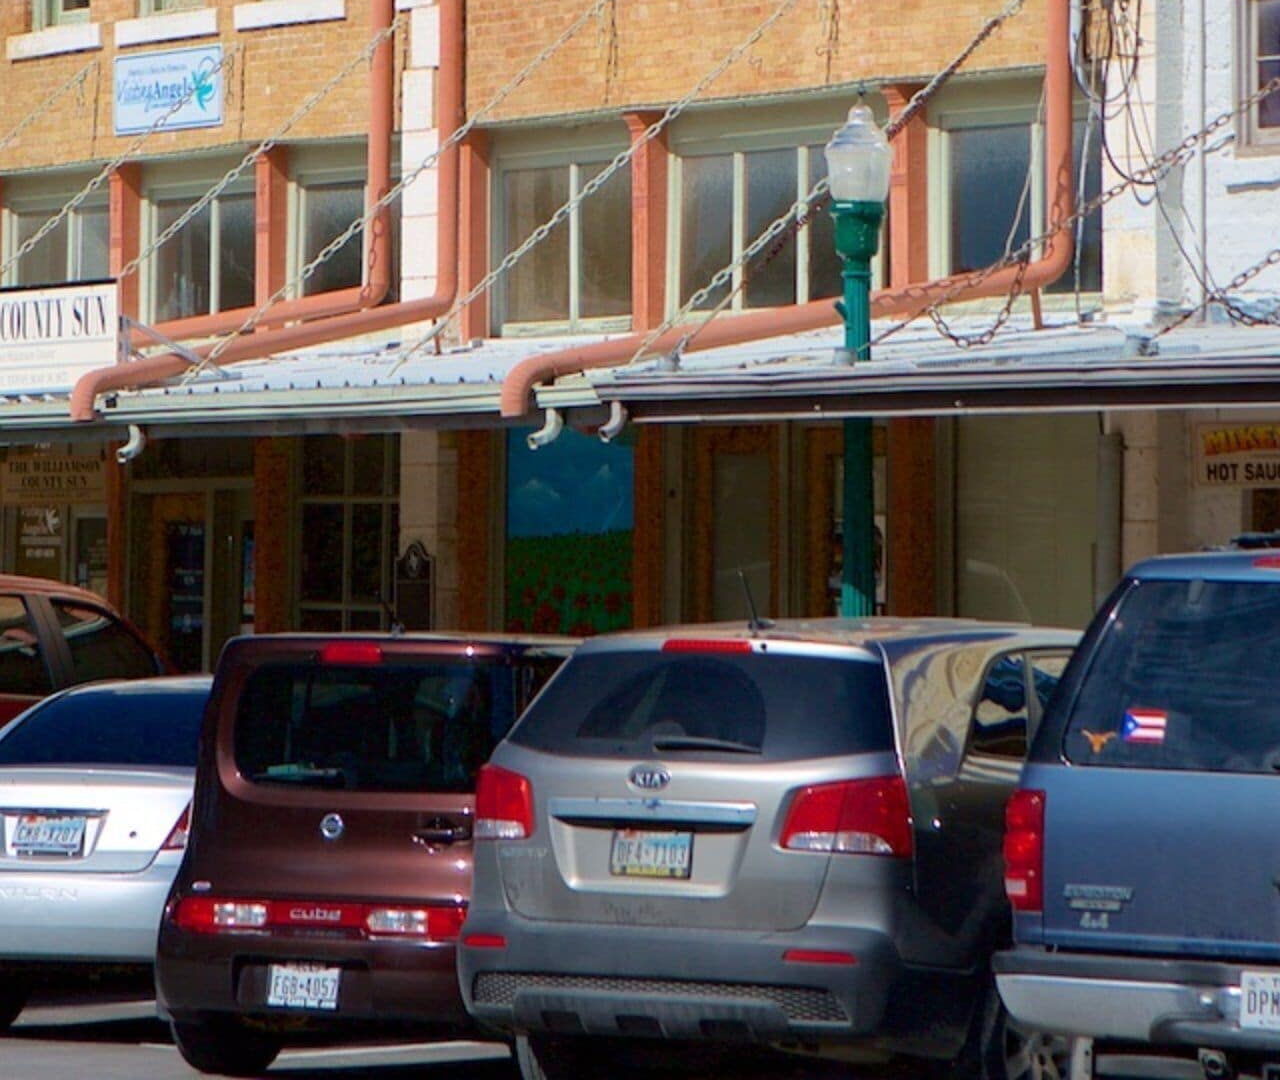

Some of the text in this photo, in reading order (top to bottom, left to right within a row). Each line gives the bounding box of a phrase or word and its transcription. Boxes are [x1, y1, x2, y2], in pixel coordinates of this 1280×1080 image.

[0, 298, 67, 342] COUNTY
[71, 294, 109, 337] SUN
[9, 460, 101, 473] THE WILLIAMSON
[1207, 463, 1239, 481] HOT
[21, 475, 87, 488] COUNTY SUN
[633, 771, 663, 787] KIA
[289, 906, 341, 921] cube
